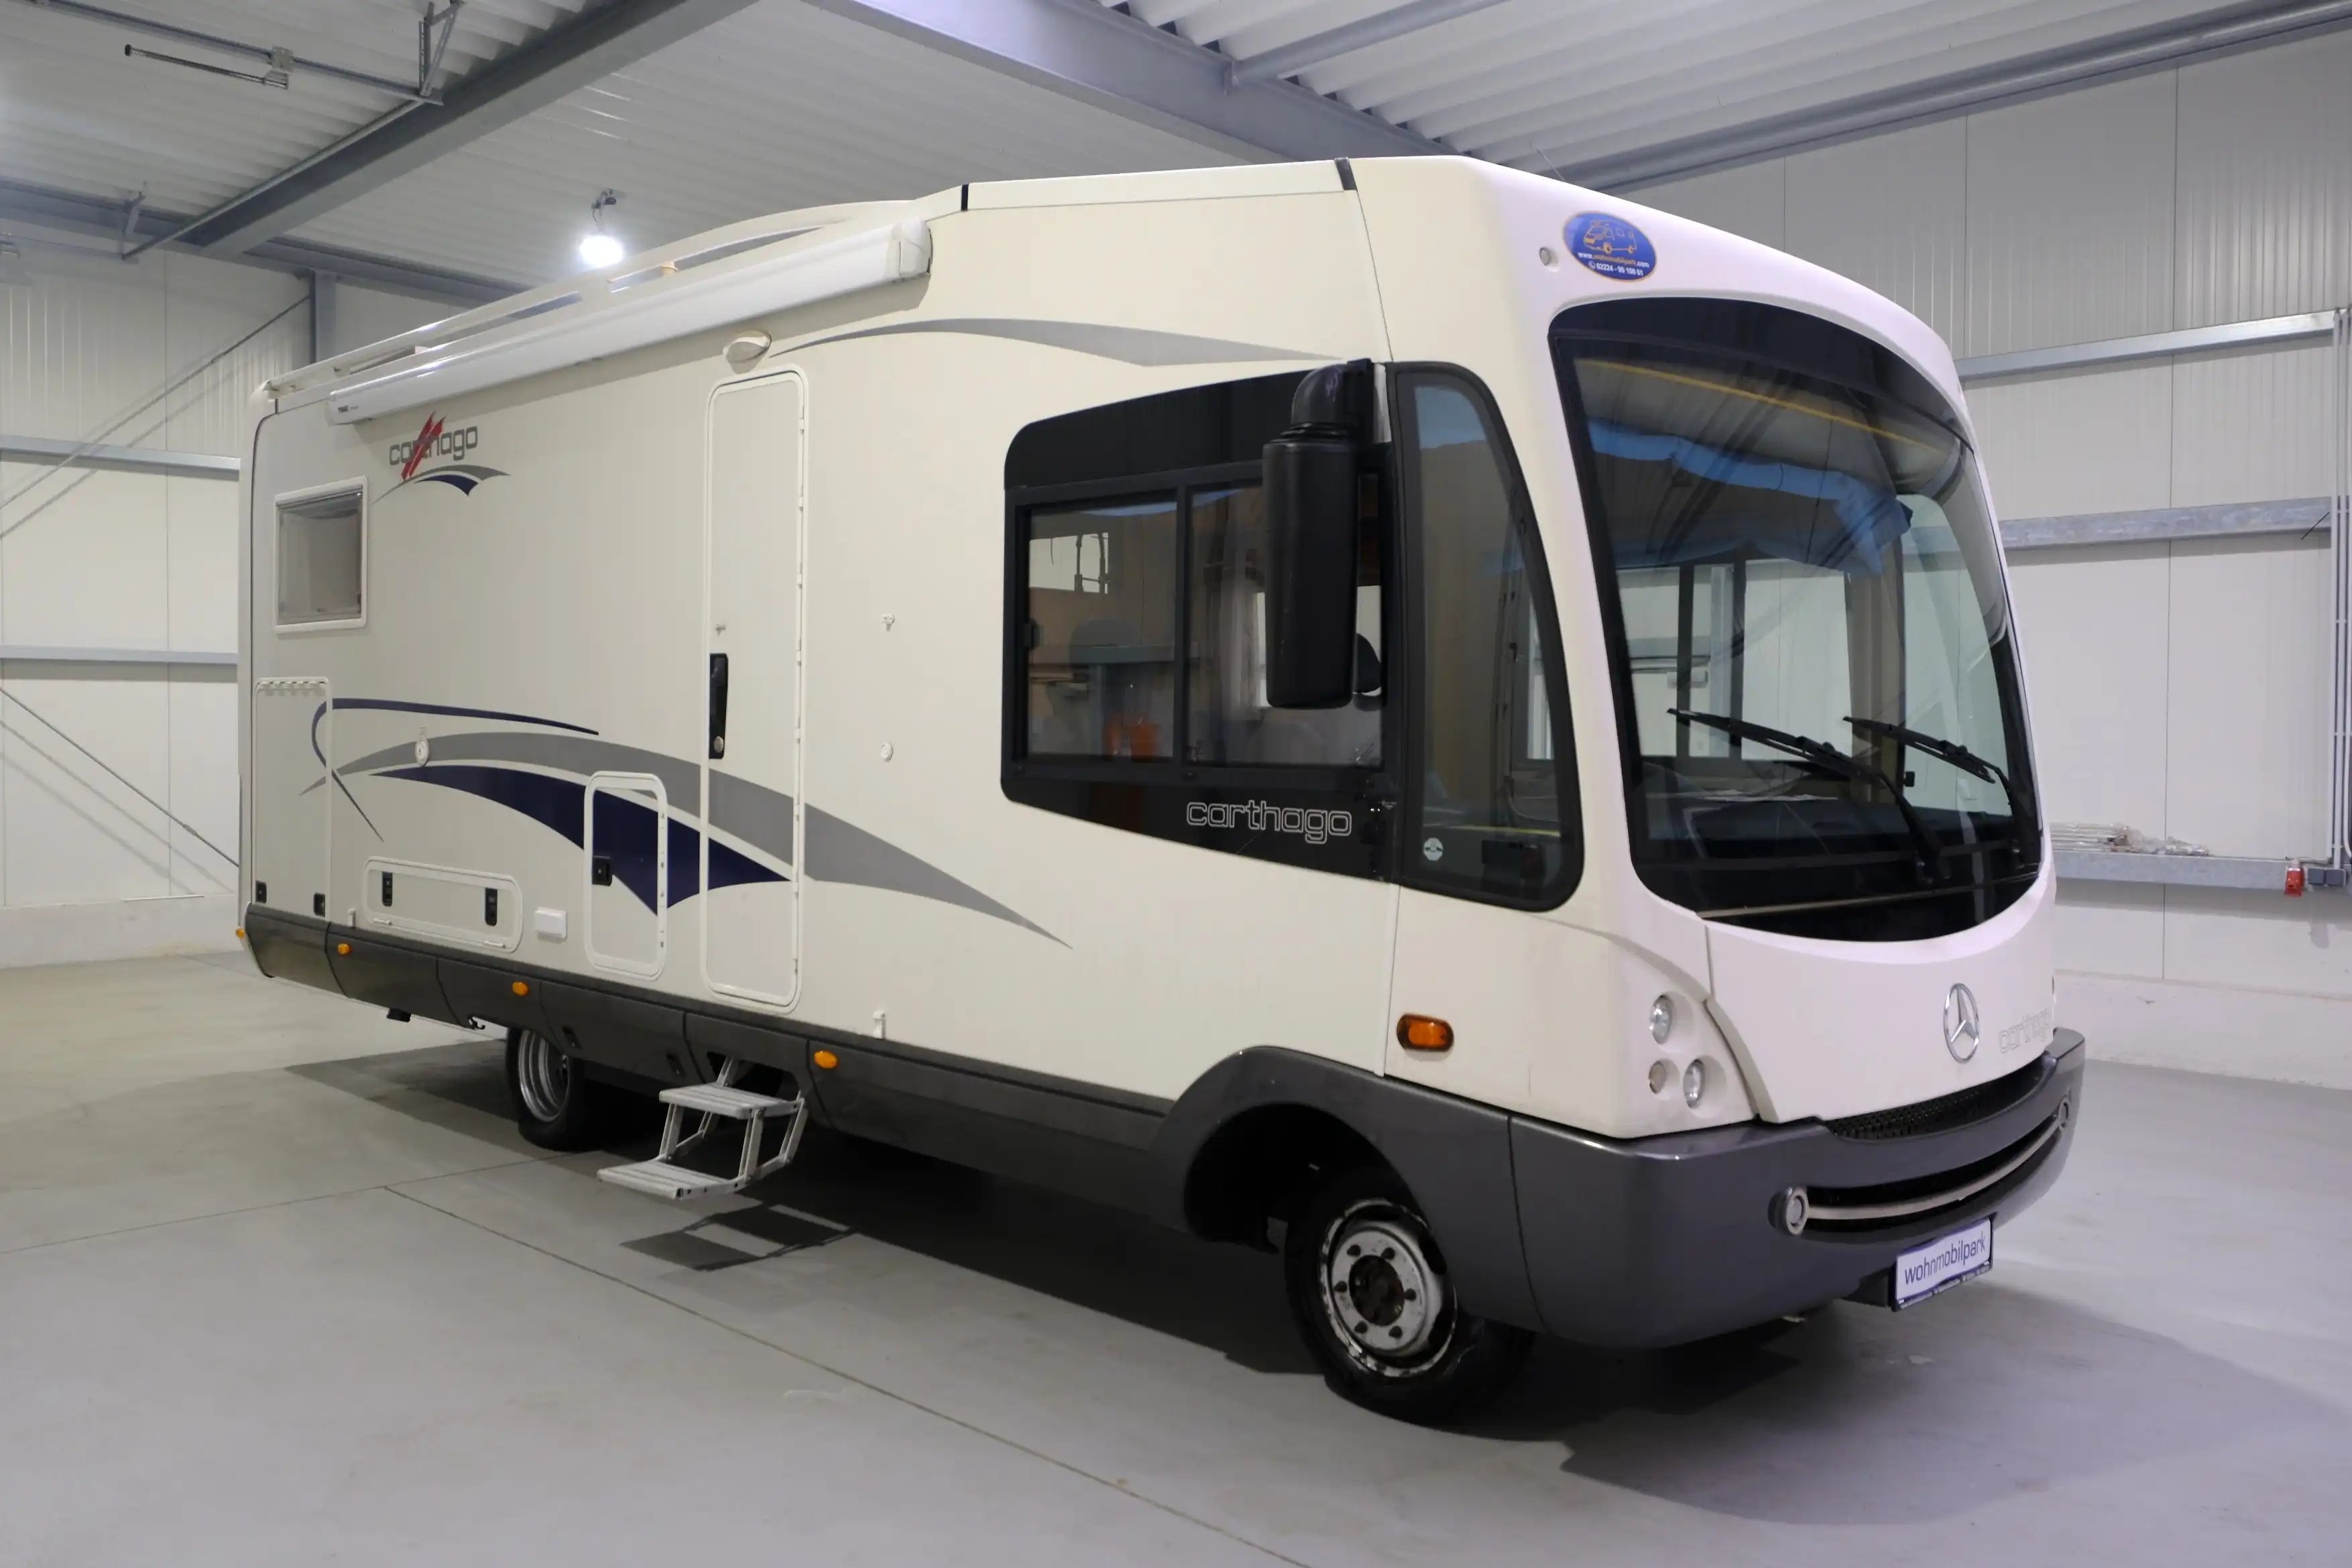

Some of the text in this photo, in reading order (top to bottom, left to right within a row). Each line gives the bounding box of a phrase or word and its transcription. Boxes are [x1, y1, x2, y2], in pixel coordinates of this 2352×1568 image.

[389, 425, 478, 466] cahago
[1186, 799, 1352, 845] carthago
[1904, 1230, 1986, 1286] wohnmobilpark
